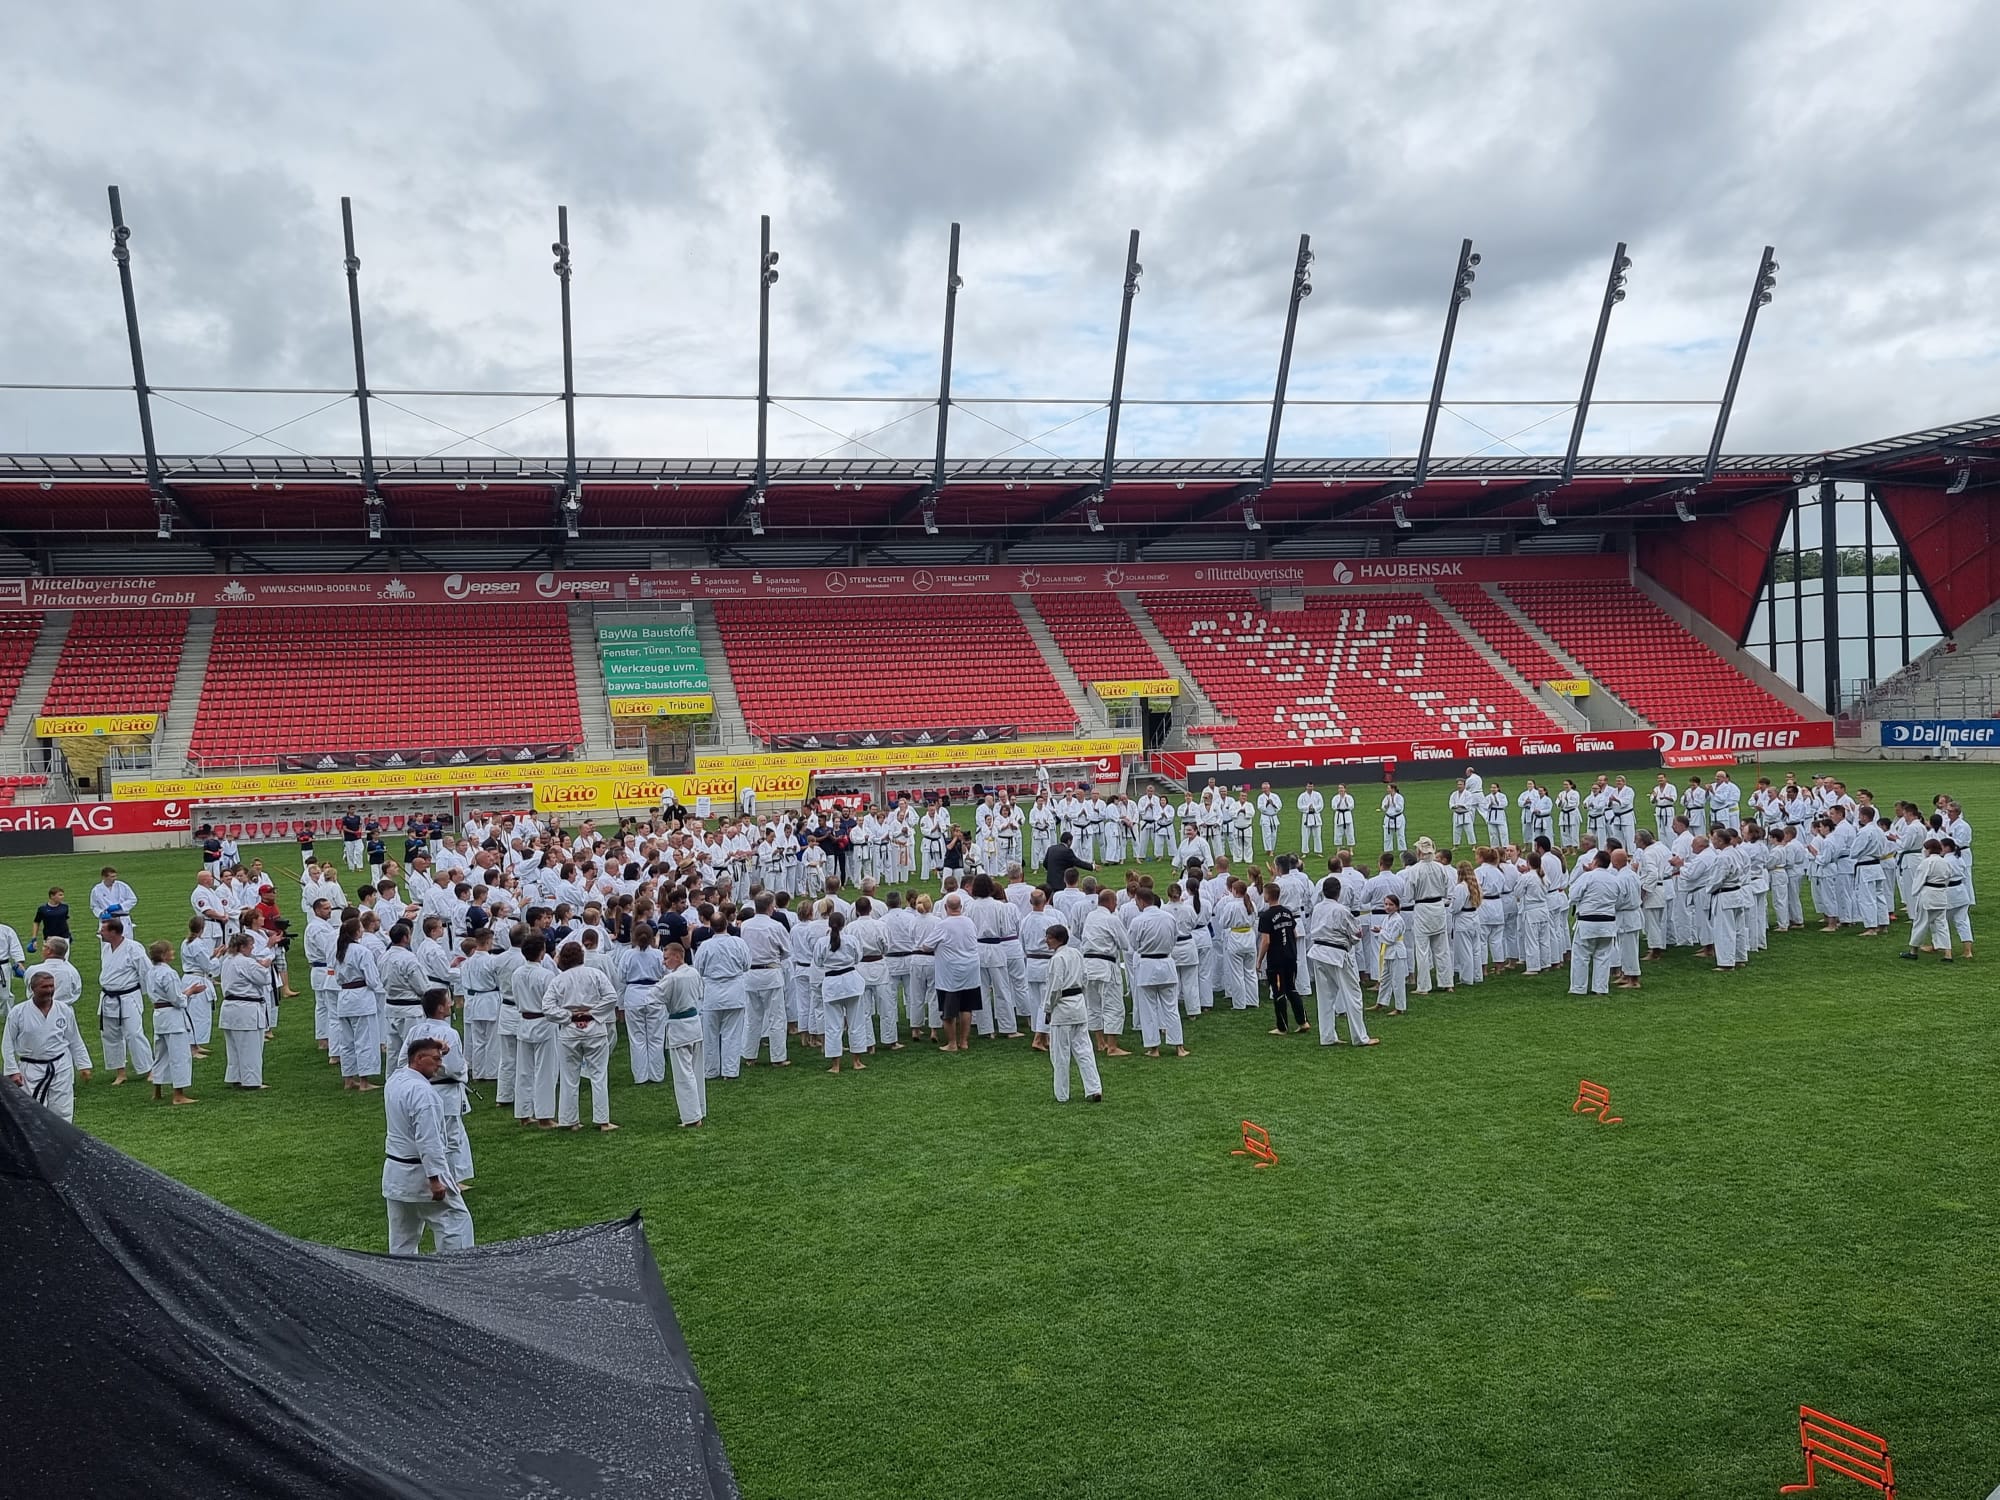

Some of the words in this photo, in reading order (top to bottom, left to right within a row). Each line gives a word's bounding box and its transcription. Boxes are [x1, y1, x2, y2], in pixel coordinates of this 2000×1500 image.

[1207, 567, 1304, 581] Mittelbayerische
[1360, 563, 1463, 577] HAUBENSAK
[704, 577, 740, 585] Sparkasse
[765, 576, 800, 584] Sparkasse
[963, 574, 990, 582] CENTER
[32, 578, 156, 592] Mittelbayerische
[260, 584, 372, 593] WWW.SCHMID-BODEN.DE
[705, 586, 747, 594] Regensburg
[766, 585, 808, 593] Regensburg
[32, 594, 147, 606] Plakatwerbung
[151, 592, 196, 604] GmbH
[215, 593, 255, 601] SCHMID
[377, 591, 415, 599] SCHMID
[600, 629, 638, 640] BayWa
[642, 626, 695, 638] Baustoffe
[603, 648, 641, 657] Fenster,
[643, 645, 673, 655] Türen,
[675, 645, 698, 653] Tore.
[610, 664, 670, 674] Werkzeuge
[608, 679, 708, 692] baywa-baustoffe.de
[1097, 685, 1127, 696] Netto
[1143, 682, 1174, 694] Netto
[615, 701, 653, 714] Netto
[668, 701, 705, 710] Tribüne
[43, 721, 87, 733] Netto
[109, 719, 153, 731] Netto
[1680, 729, 1800, 750] Dallmeier
[1912, 725, 1994, 741] Dallmeier
[1468, 746, 1508, 757] REWAG
[1522, 743, 1561, 755] REWAG
[1576, 741, 1614, 752] REWAG
[1413, 749, 1453, 761] REWAG
[118, 785, 147, 795] Netto
[156, 783, 185, 793] Netto
[194, 781, 223, 791] Netto
[232, 780, 261, 789] Netto
[269, 778, 298, 788] Netto
[305, 776, 334, 786] Netto
[341, 775, 370, 785] Netto
[378, 773, 406, 783] Netto
[414, 771, 441, 781] Netto
[449, 770, 476, 779] Netto
[484, 768, 511, 777] Netto
[517, 767, 545, 776] Netto
[552, 766, 578, 775] Netto
[585, 764, 611, 773] Netto
[619, 763, 644, 772] Netto
[752, 775, 804, 792] Netto
[541, 784, 597, 803] Netto
[613, 781, 667, 799] Netto
[683, 778, 736, 796] Netto
[65, 806, 114, 831] AG
